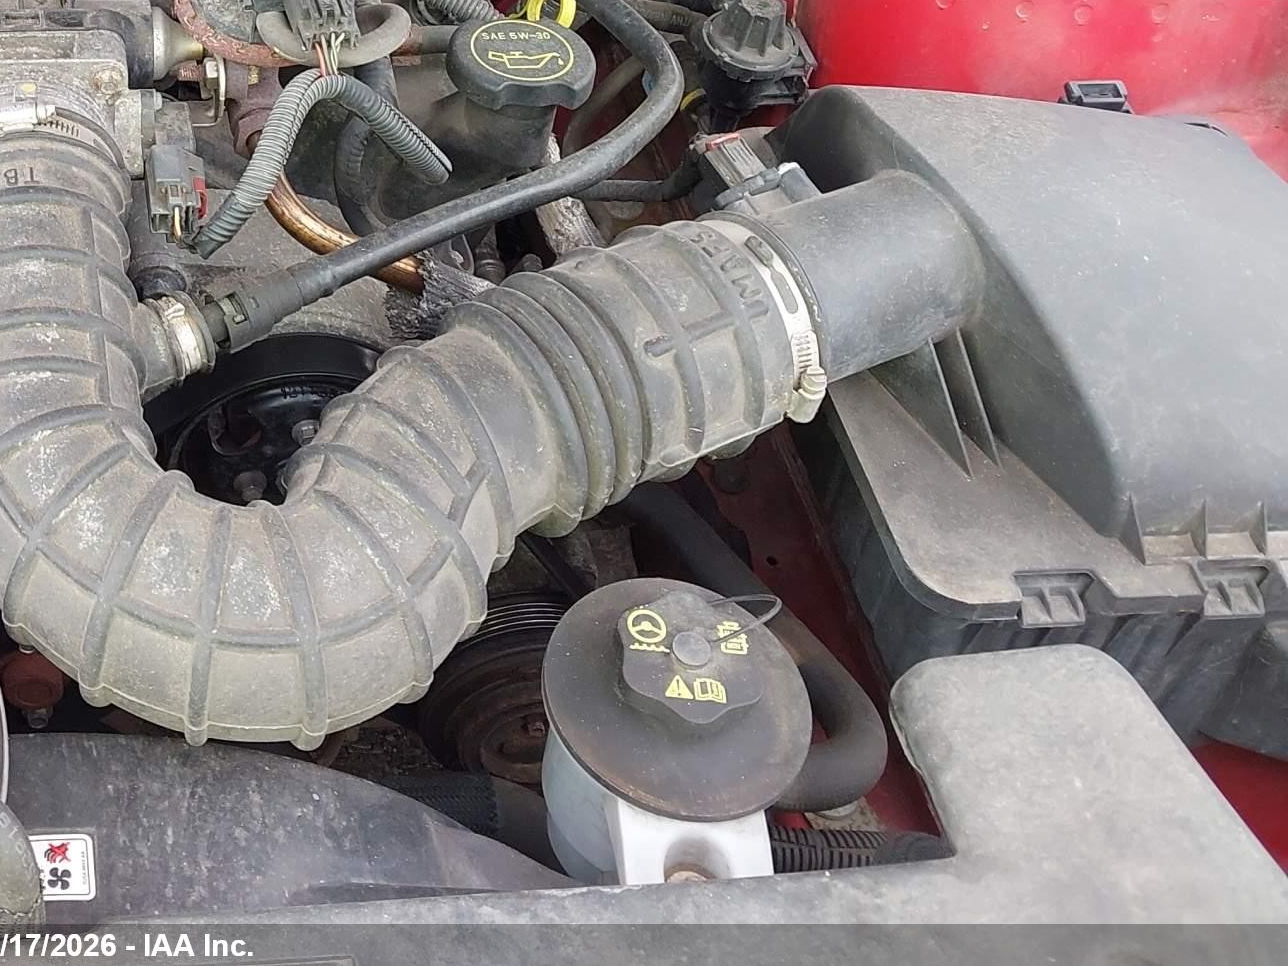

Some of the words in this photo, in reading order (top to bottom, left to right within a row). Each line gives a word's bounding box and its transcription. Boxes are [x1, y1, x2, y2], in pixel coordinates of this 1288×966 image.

[481, 31, 506, 41] SAE
[509, 32, 551, 41] 5W-30
[4, 166, 40, 186] TB
